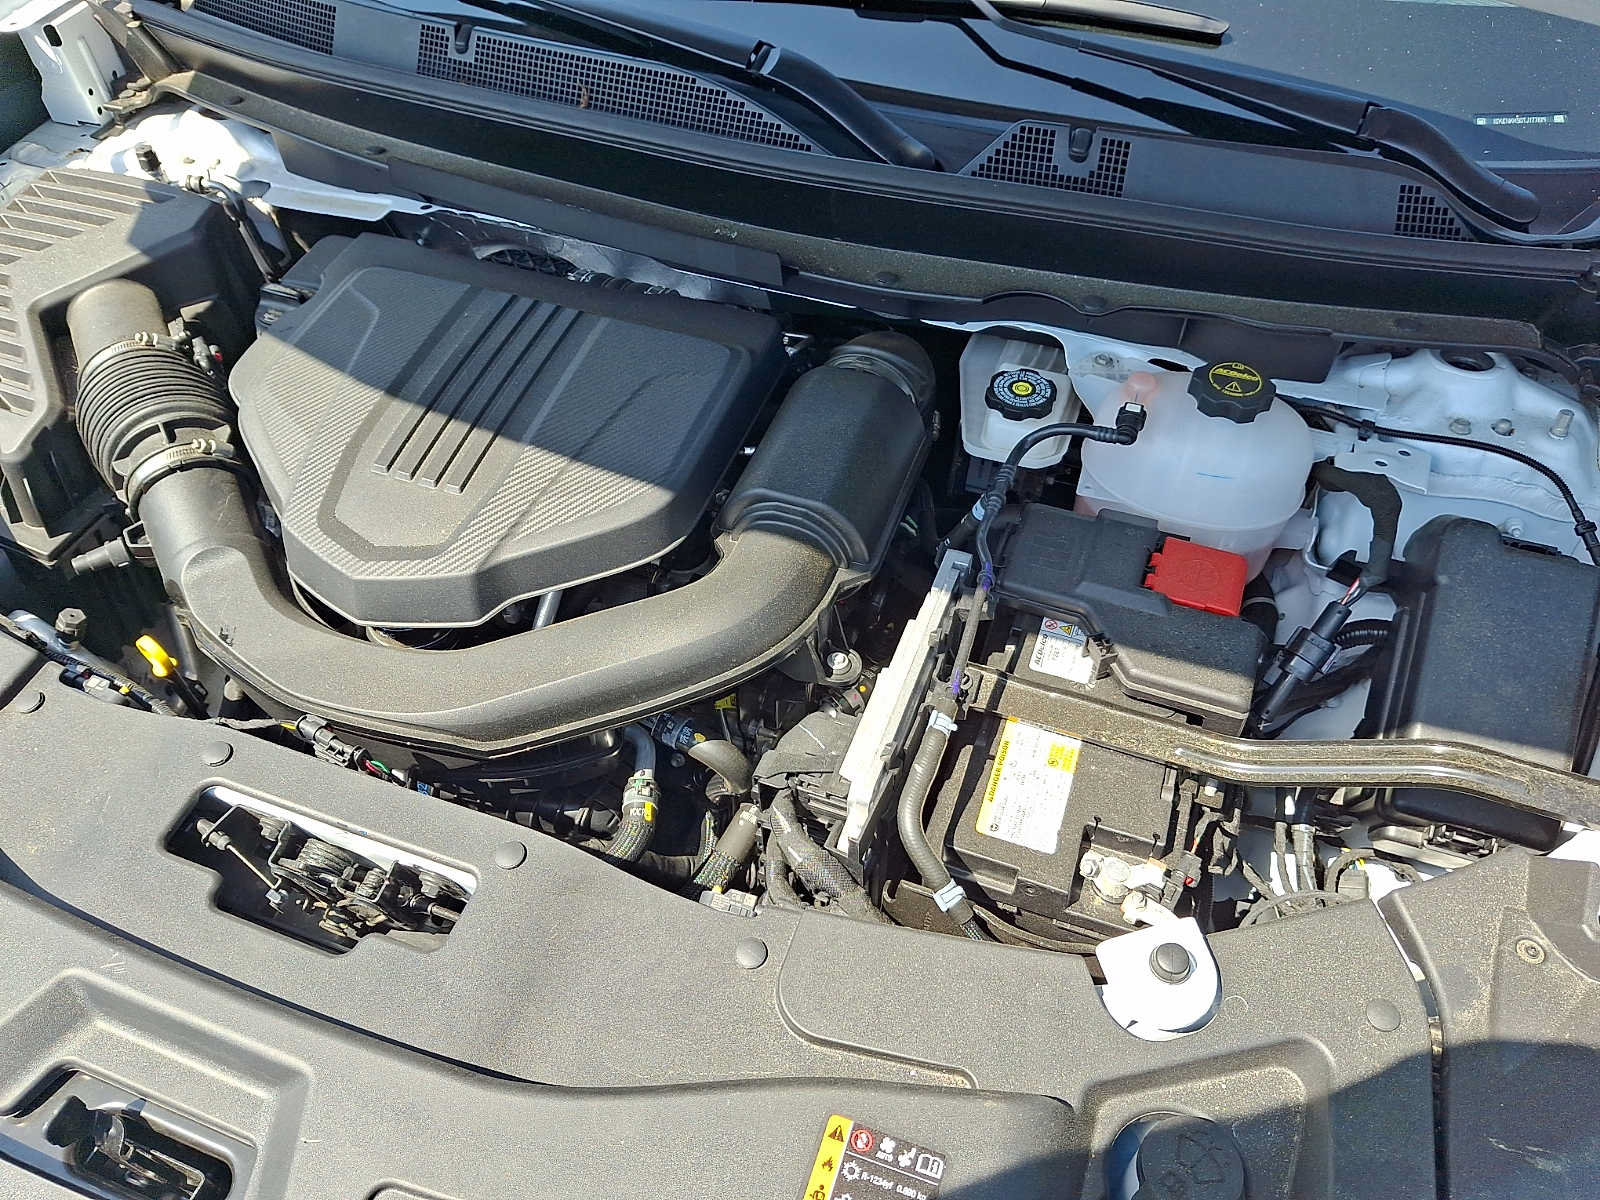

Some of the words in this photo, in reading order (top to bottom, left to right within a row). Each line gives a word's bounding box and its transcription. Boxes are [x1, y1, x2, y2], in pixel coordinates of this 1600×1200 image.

[1213, 368, 1259, 381] ACDelco
[988, 765, 1002, 796] DANGER
[998, 740, 1011, 767] POISON
